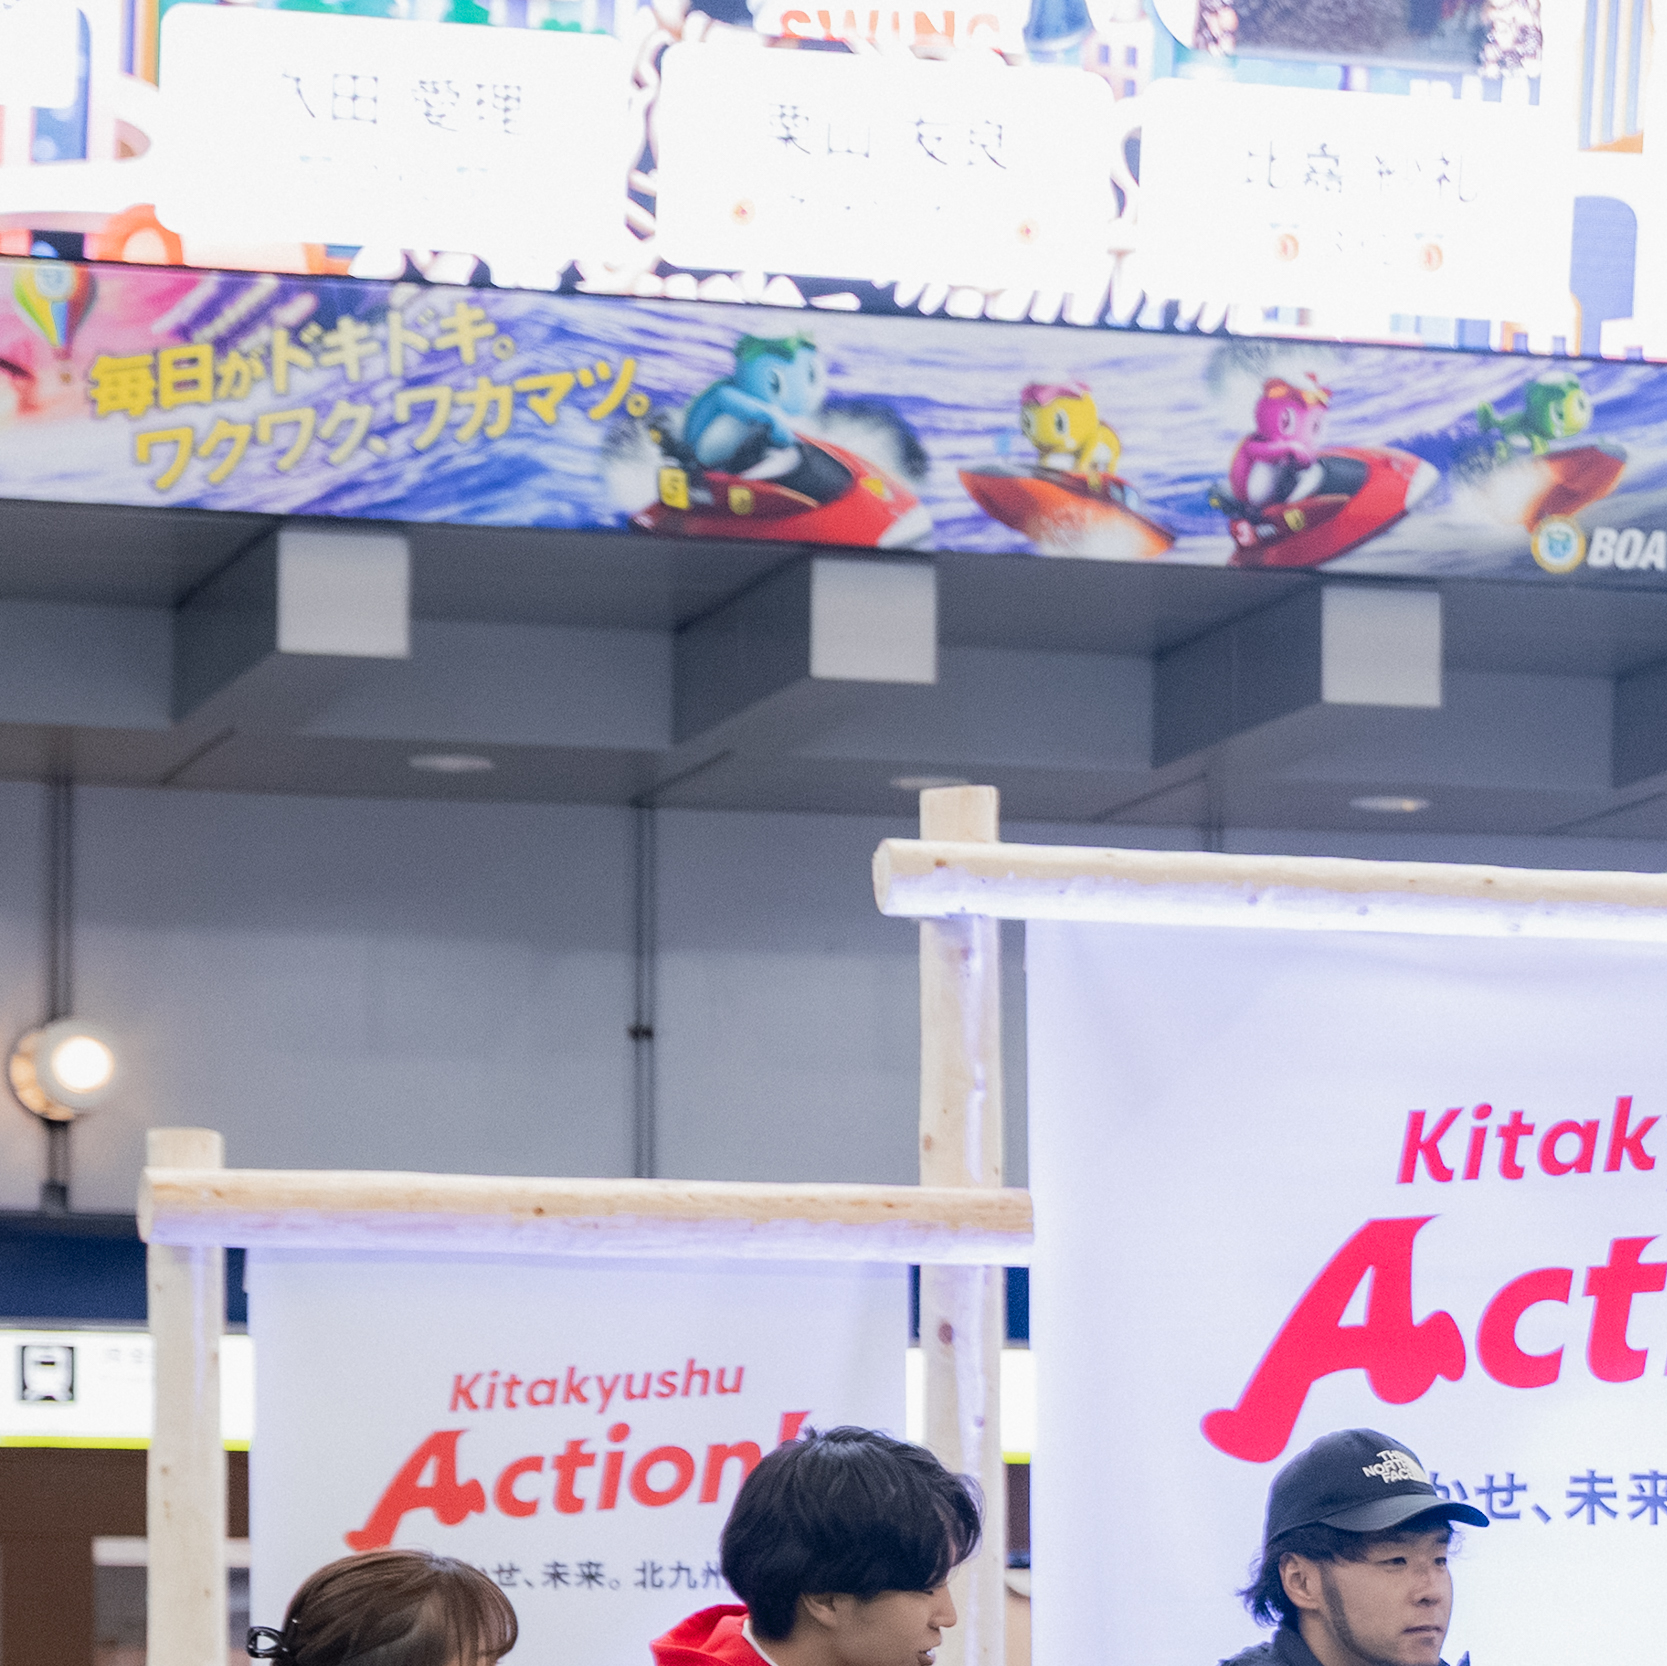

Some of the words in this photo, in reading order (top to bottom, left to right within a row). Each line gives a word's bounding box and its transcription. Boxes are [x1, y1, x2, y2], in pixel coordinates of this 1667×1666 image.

[89, 301, 517, 414] 毎日がドキドキ。
[133, 355, 651, 492] ワクワク、ワカマツ。
[448, 1357, 745, 1415] Kitakyushu
